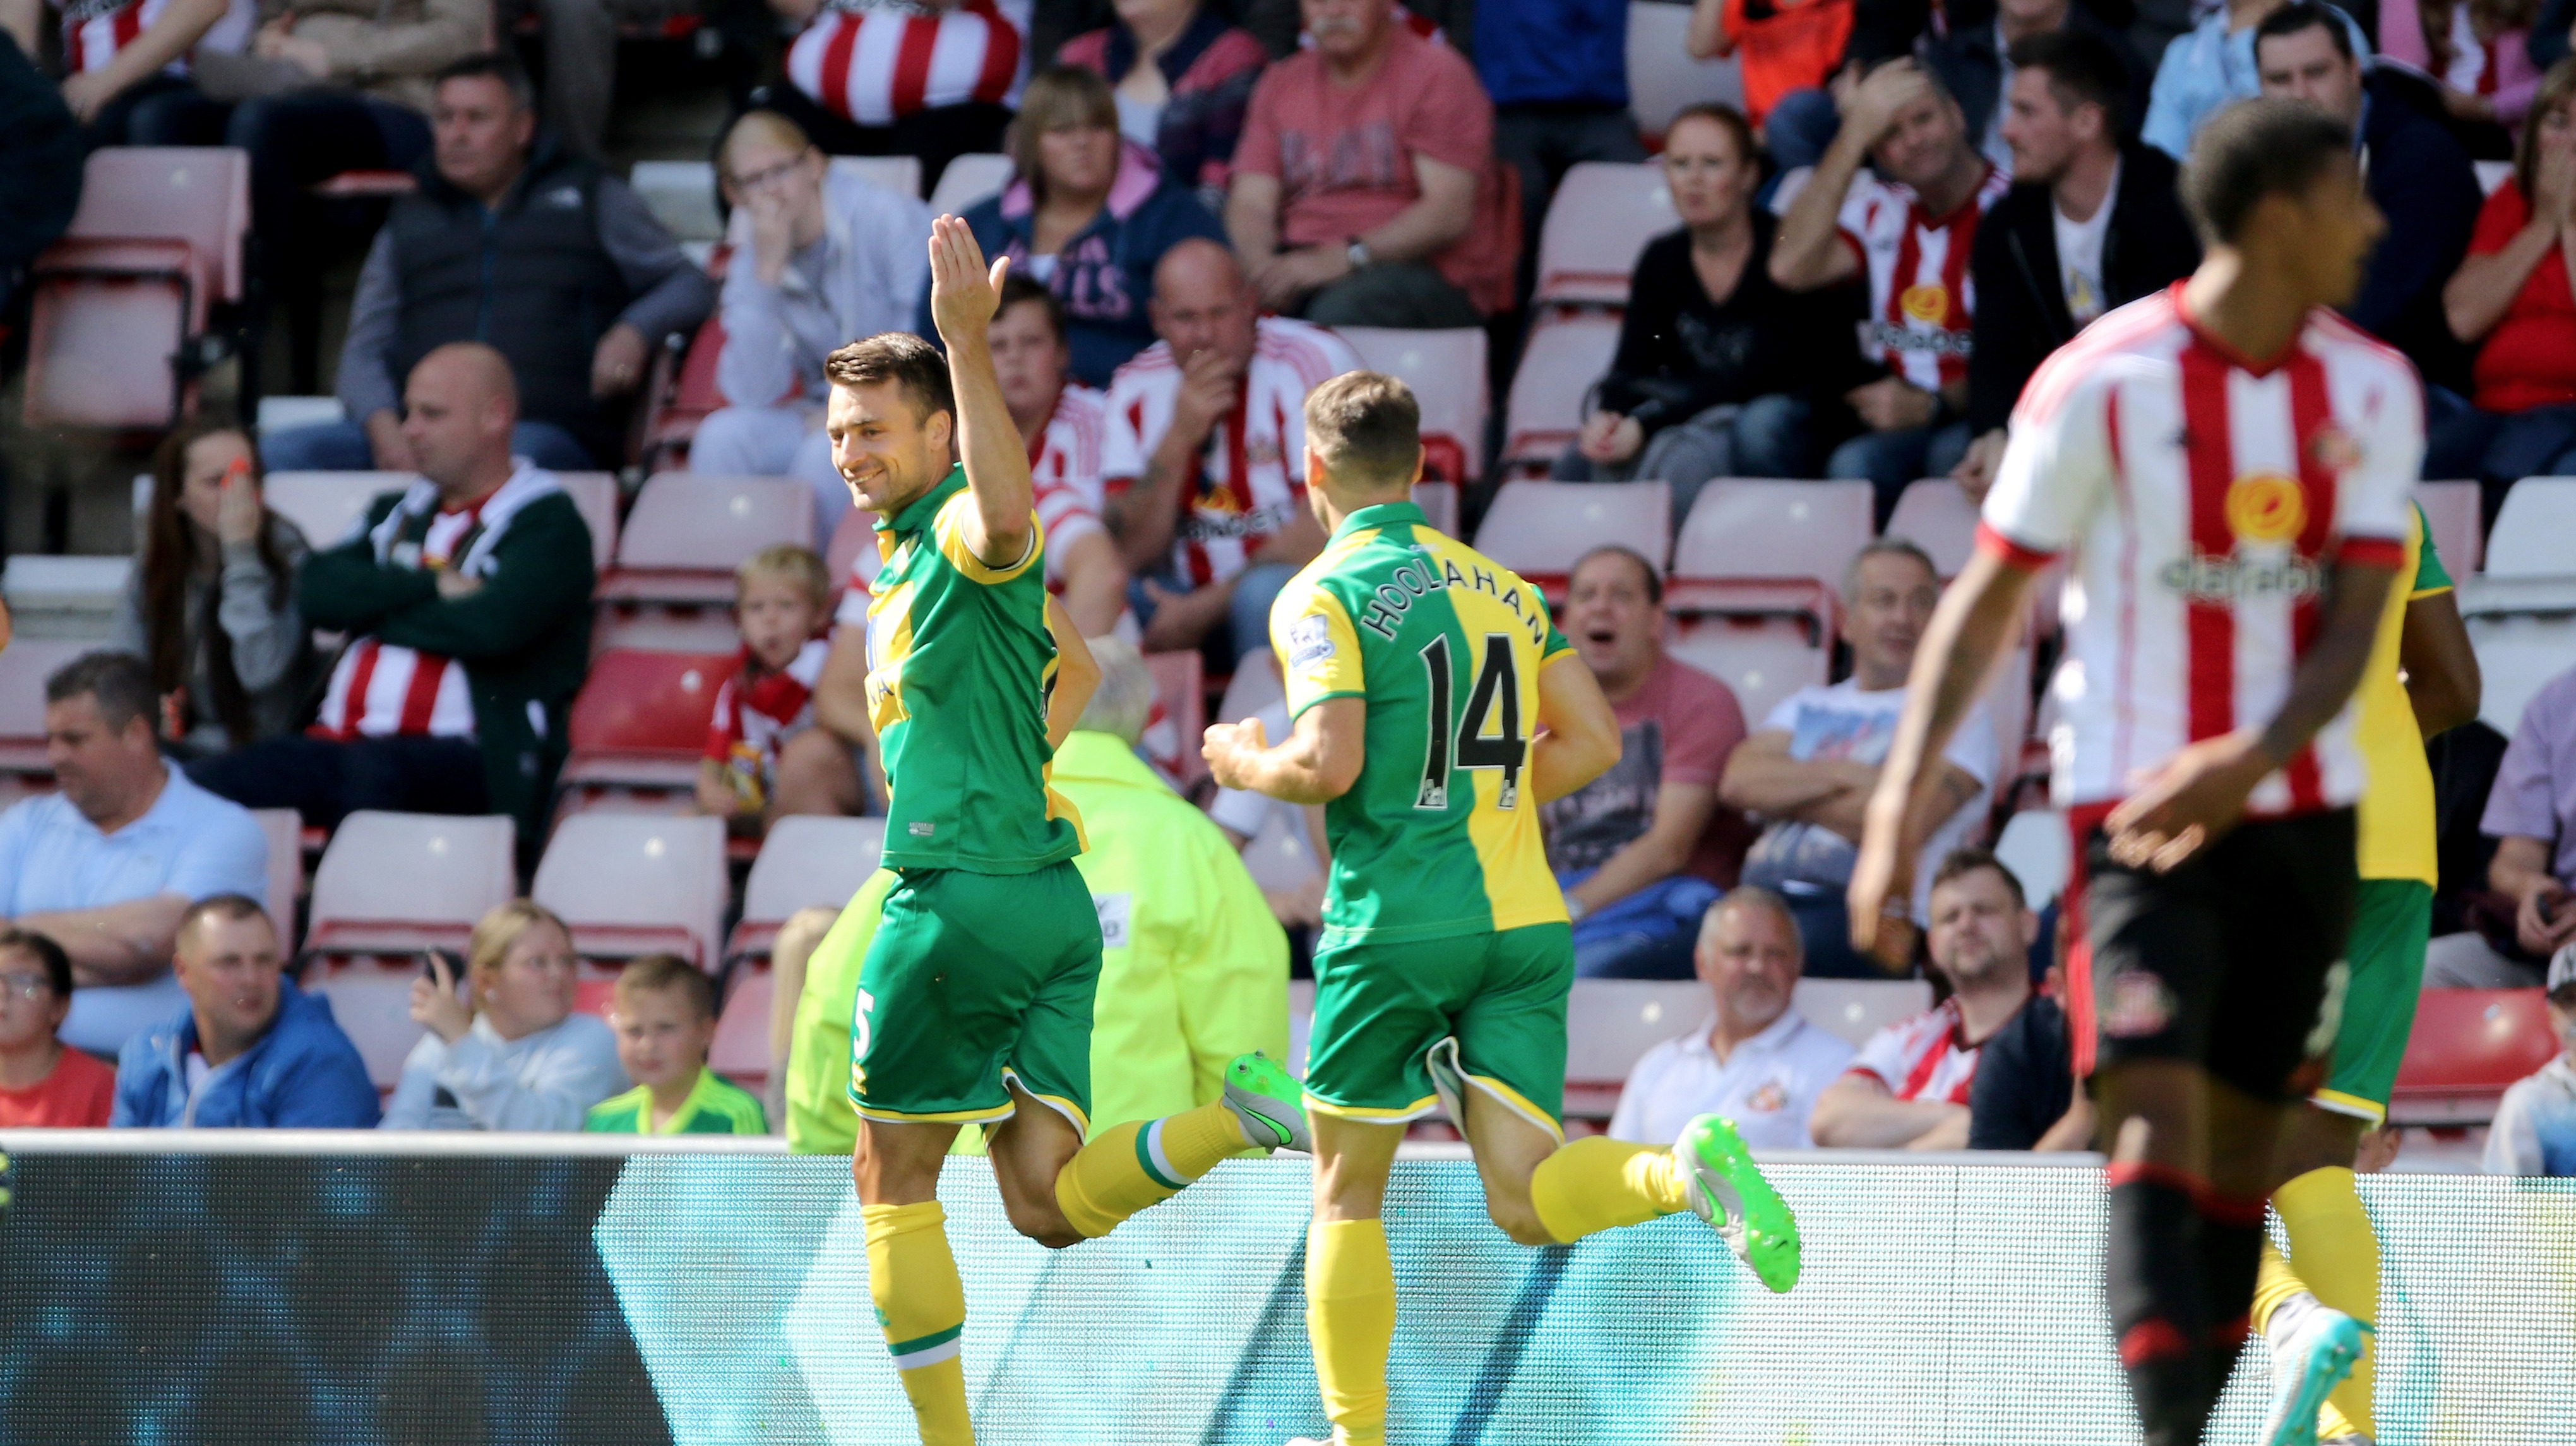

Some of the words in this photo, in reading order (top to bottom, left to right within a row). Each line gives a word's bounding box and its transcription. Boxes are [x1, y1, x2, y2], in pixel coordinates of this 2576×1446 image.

[1359, 558, 1544, 647] HOOLAHAN
[1413, 631, 1527, 810] 14
[853, 988, 874, 1060] 5
